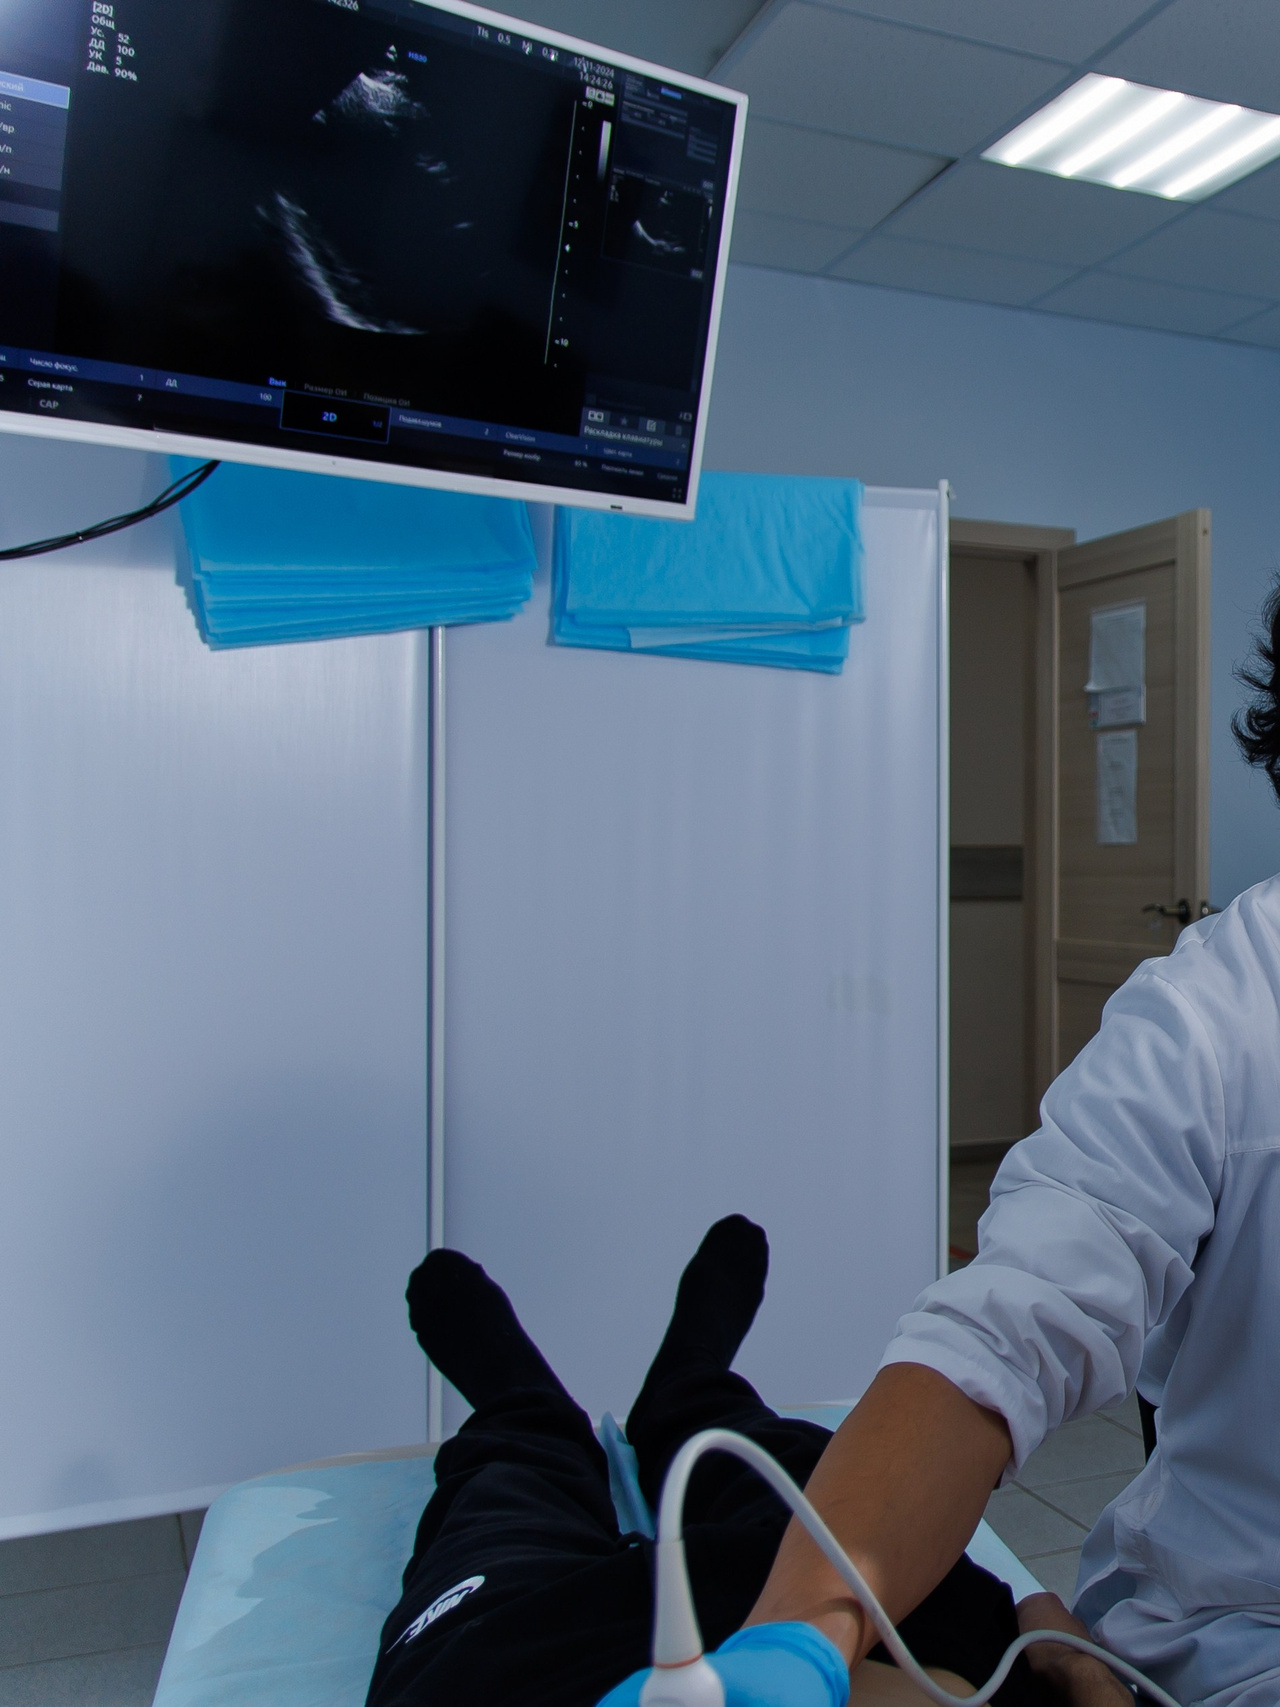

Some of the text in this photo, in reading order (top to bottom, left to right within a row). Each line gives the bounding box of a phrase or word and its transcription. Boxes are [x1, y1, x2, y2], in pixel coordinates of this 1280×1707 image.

[92, 1, 114, 17] [2D]
[91, 15, 115, 29] Общ
[118, 33, 130, 45] 52
[497, 33, 511, 45] 0.5
[89, 38, 135, 57] ДД 100
[89, 49, 122, 65] УК 5
[114, 68, 138, 81] 90%
[580, 72, 613, 90] 14:24:26
[322, 411, 337, 422] 2D
